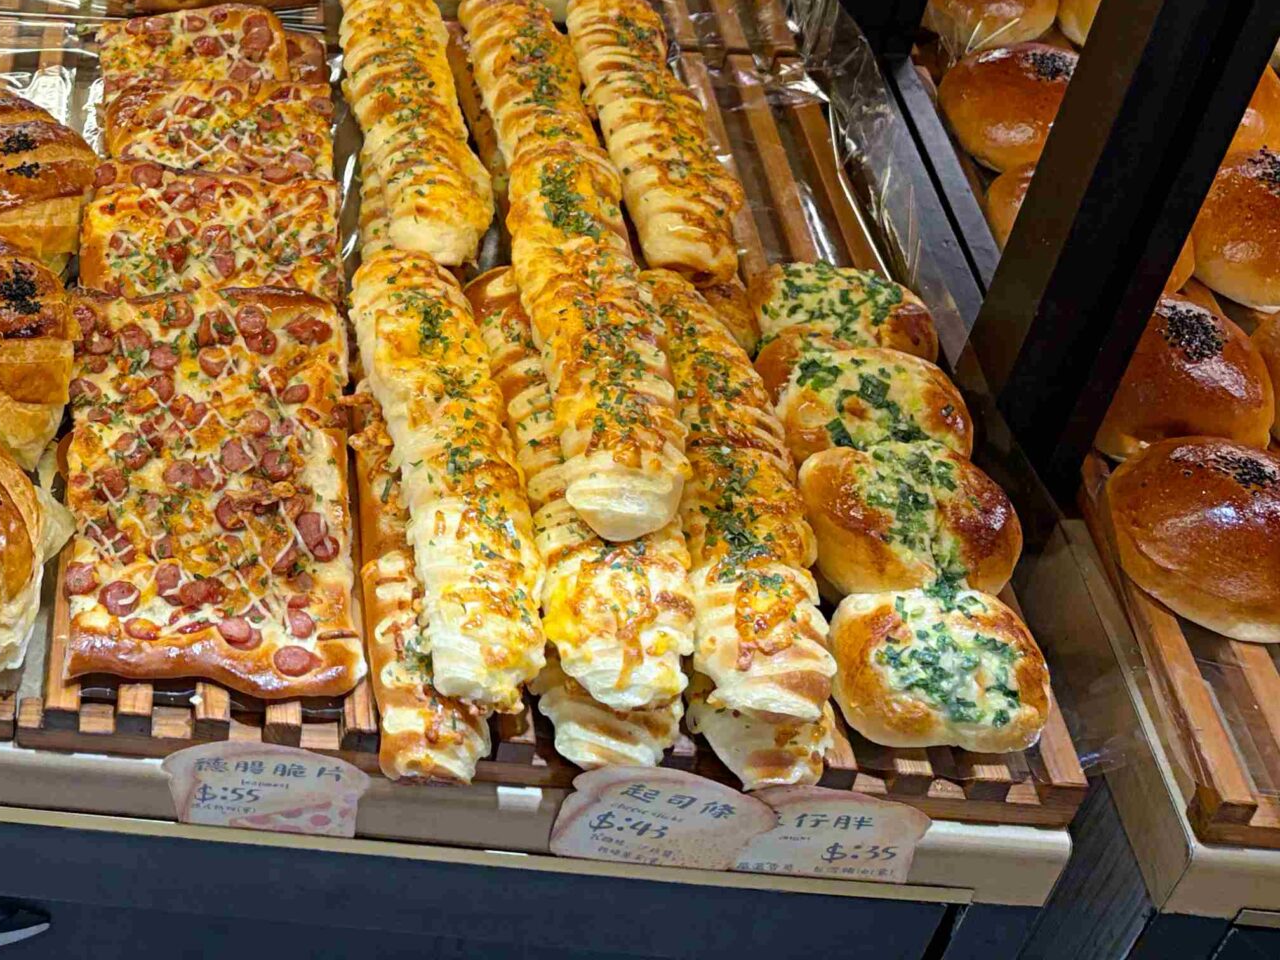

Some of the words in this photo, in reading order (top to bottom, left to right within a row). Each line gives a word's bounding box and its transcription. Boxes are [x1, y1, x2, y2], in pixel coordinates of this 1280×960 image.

[195, 784, 262, 803] $:55
[621, 784, 736, 819] 起司條
[776, 812, 874, 830] 仔胖
[821, 843, 899, 863] $:35
